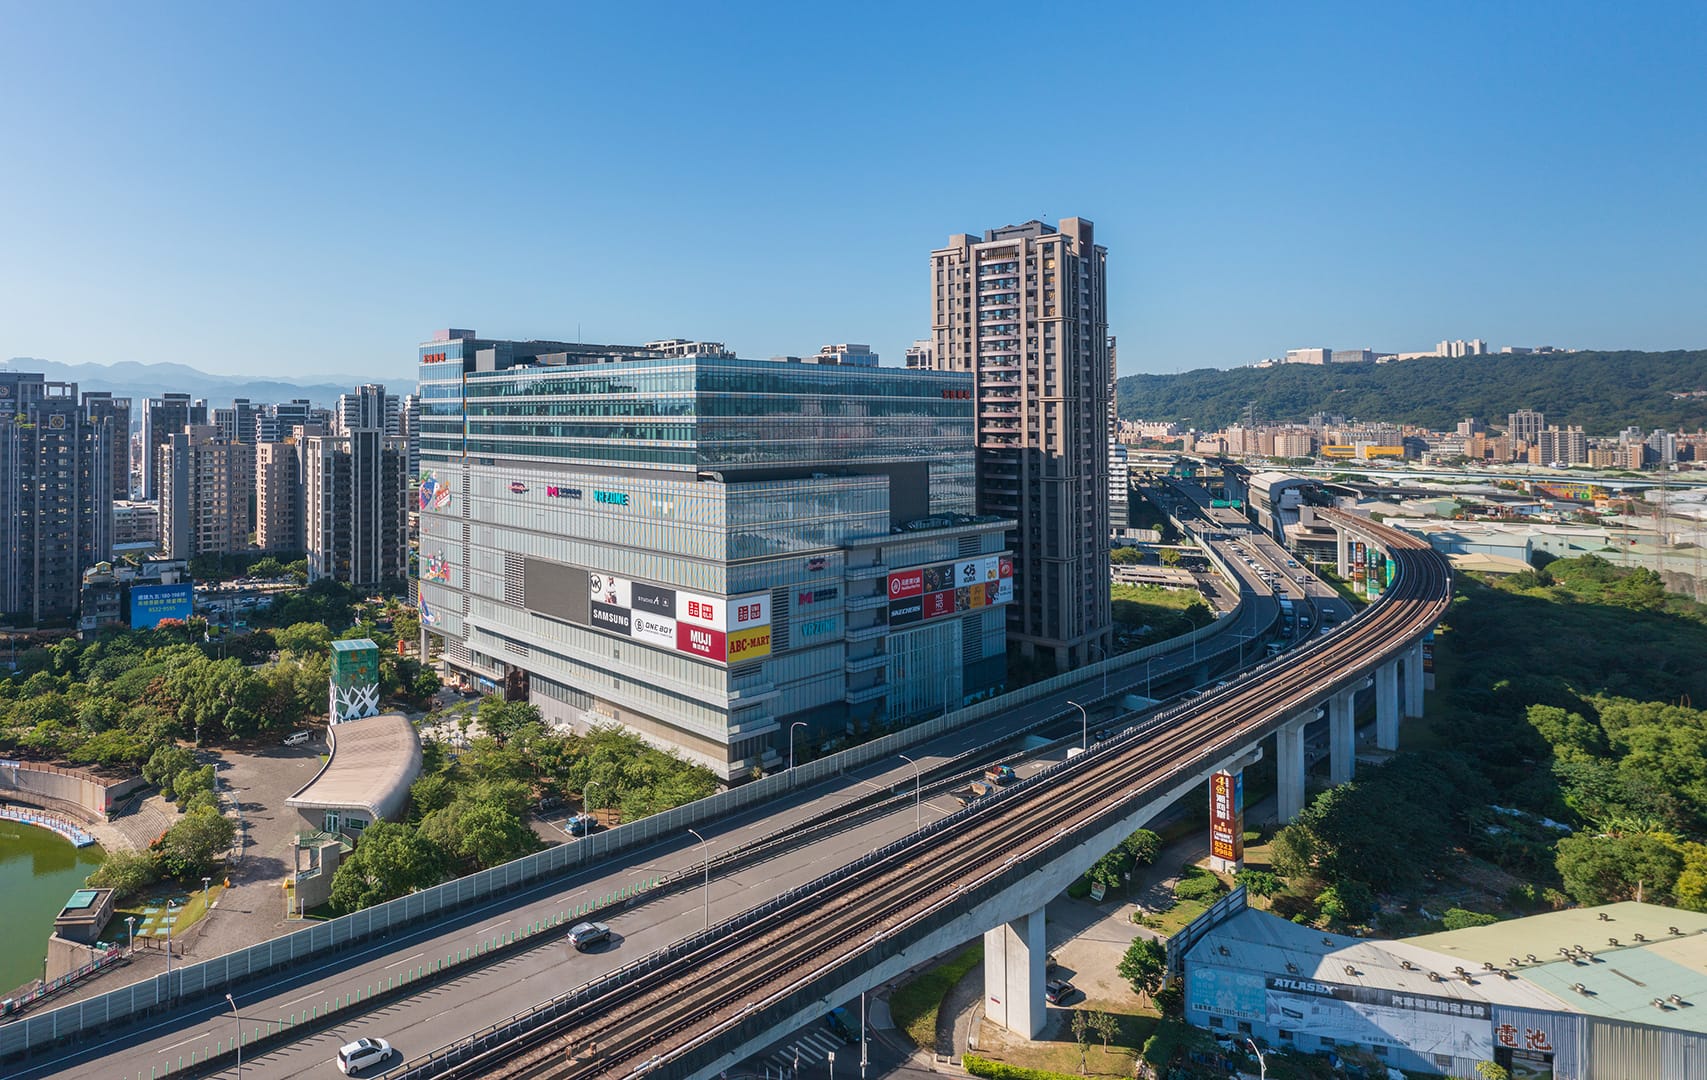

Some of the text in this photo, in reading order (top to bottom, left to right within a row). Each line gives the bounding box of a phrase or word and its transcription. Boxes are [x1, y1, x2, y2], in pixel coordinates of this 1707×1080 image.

[593, 609, 629, 627] SAMSUNG
[690, 629, 712, 646] MUJI
[729, 635, 770, 654] ABC-MART
[1274, 977, 1334, 995] ATLASBX
[1494, 1024, 1552, 1051] 電池
